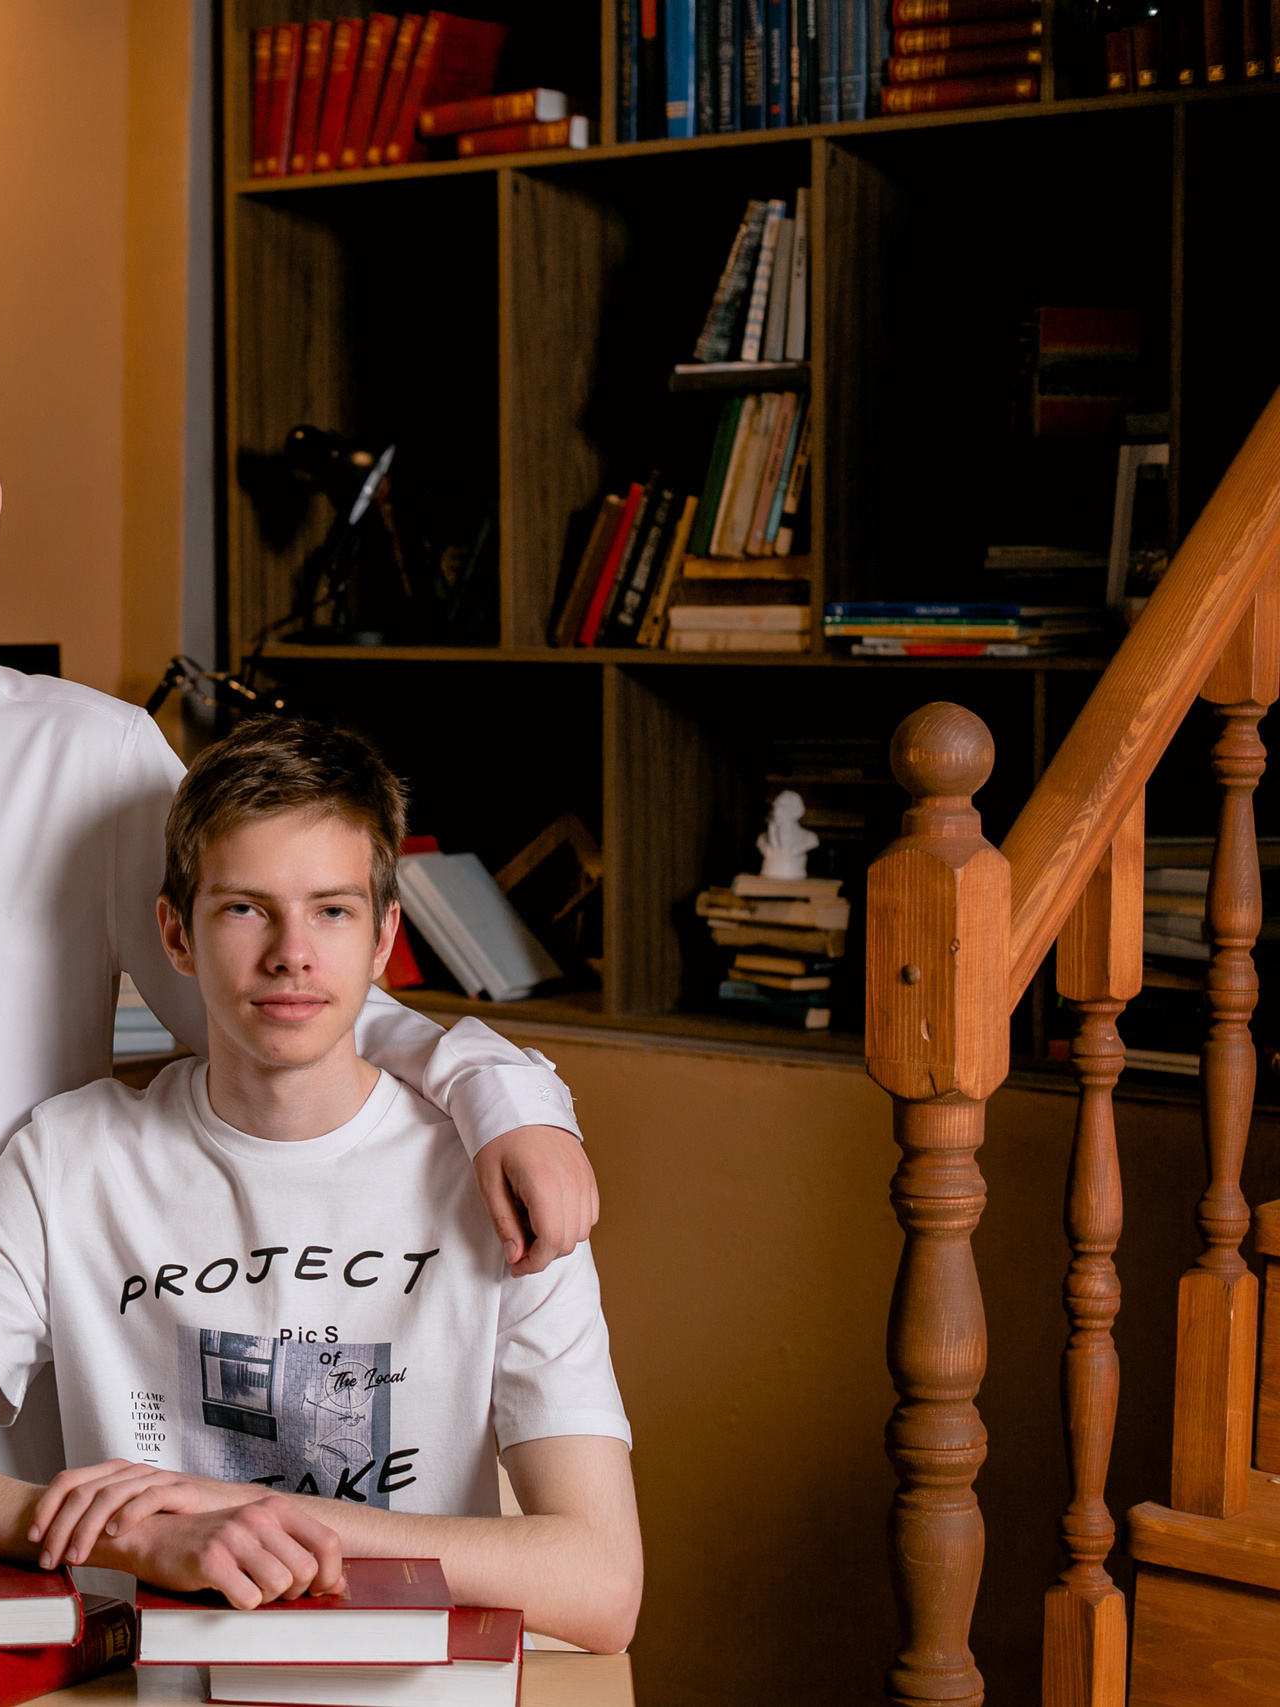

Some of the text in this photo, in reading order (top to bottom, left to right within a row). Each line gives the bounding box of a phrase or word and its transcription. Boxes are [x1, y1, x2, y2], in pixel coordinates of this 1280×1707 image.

[120, 1246, 440, 1315] PROJECT
[320, 1351, 342, 1366] of
[329, 1367, 407, 1392] The Local
[137, 1391, 165, 1403] CAME
[140, 1402, 161, 1411] SAW
[136, 1412, 166, 1421] TOOK
[137, 1422, 157, 1431] THE
[134, 1432, 166, 1441] PHOTO
[136, 1443, 161, 1452] CLICK
